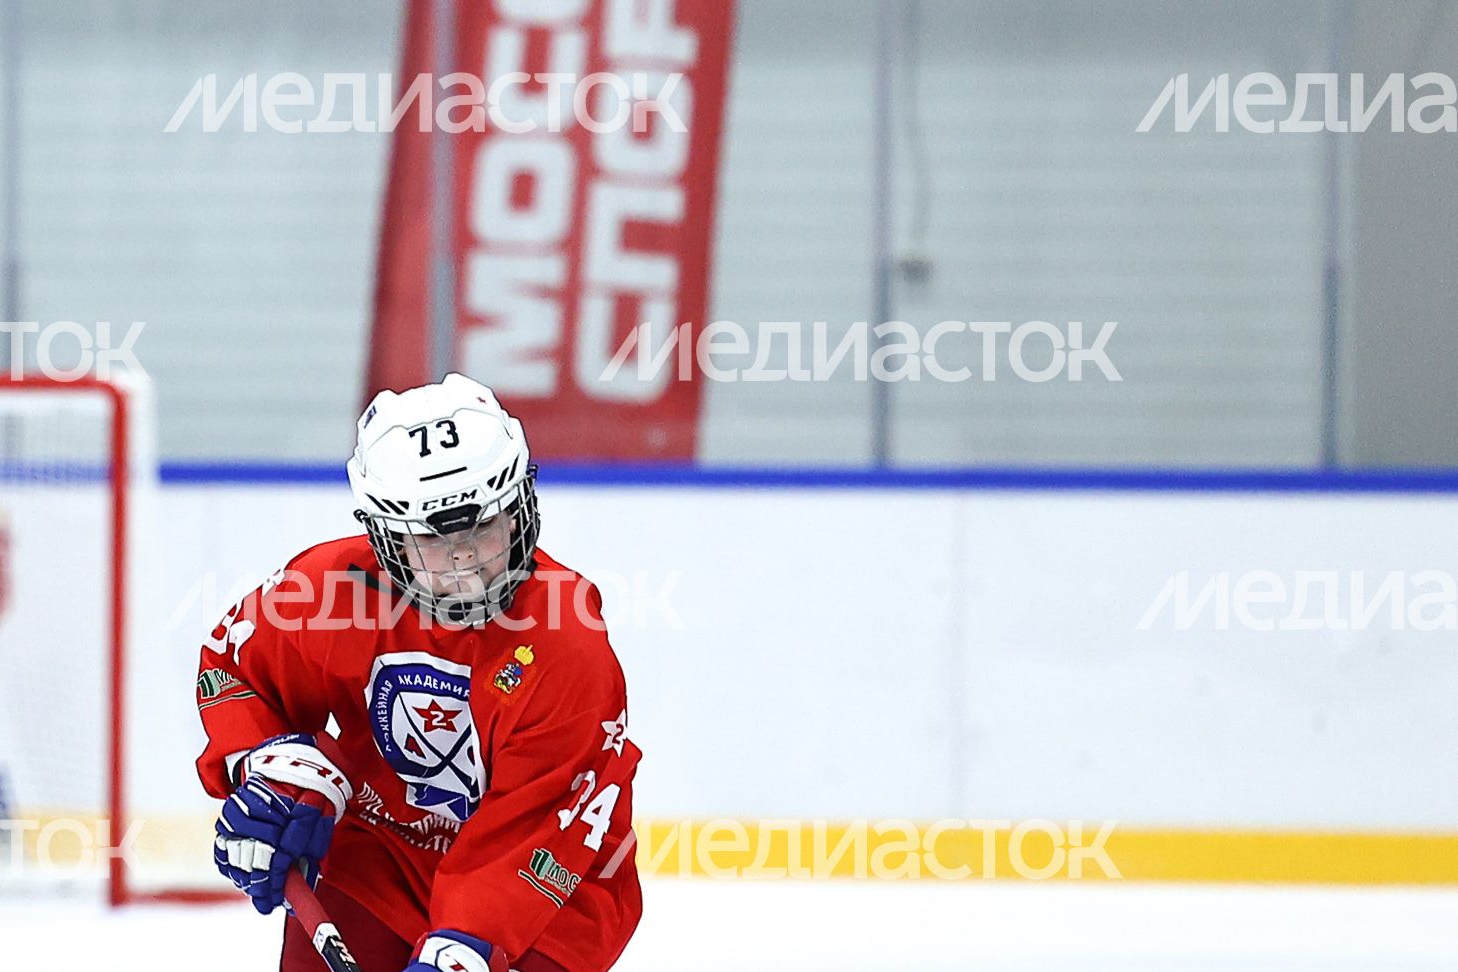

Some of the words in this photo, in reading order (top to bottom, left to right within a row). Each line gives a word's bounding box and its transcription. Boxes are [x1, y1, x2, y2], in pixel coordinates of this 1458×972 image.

[460, 0, 590, 397] МОС
[408, 420, 460, 458] 73
[421, 489, 478, 511] CCM
[397, 672, 471, 698] АКАДЕМИЯ
[430, 710, 448, 726] 2
[611, 723, 625, 745] 2
